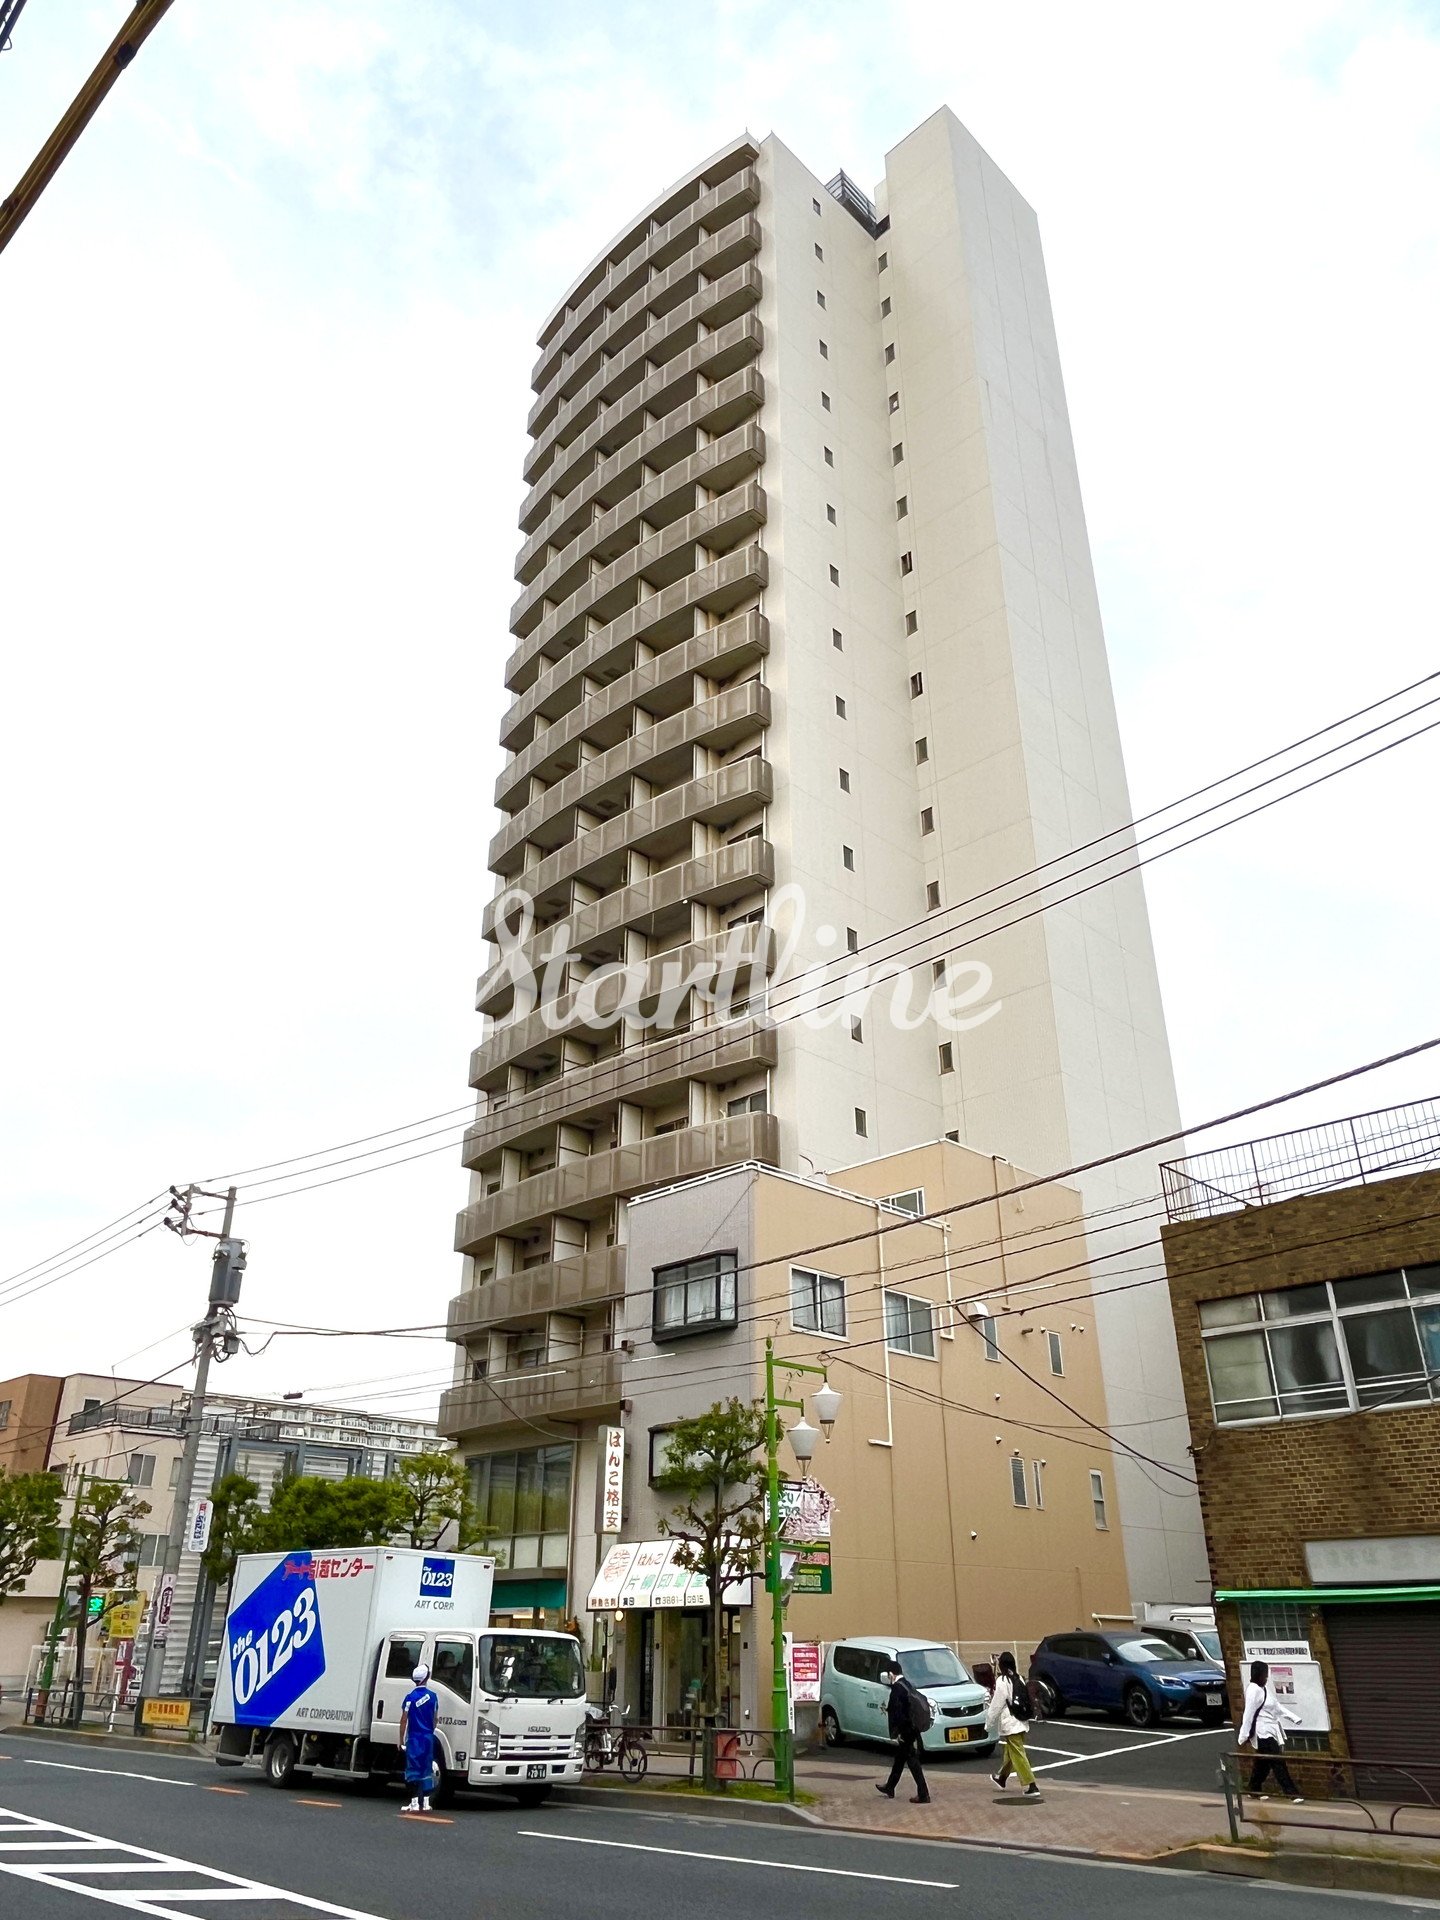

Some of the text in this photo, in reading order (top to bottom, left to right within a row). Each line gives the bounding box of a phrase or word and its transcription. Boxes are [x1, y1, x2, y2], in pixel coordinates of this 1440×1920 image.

[606, 1431, 622, 1528] はんこ格安
[422, 1571, 453, 1587] 0123
[414, 1600, 431, 1609] ART
[232, 1629, 253, 1660] the
[234, 1587, 317, 1705] 0123
[296, 1707, 353, 1721] ART CORPORATION
